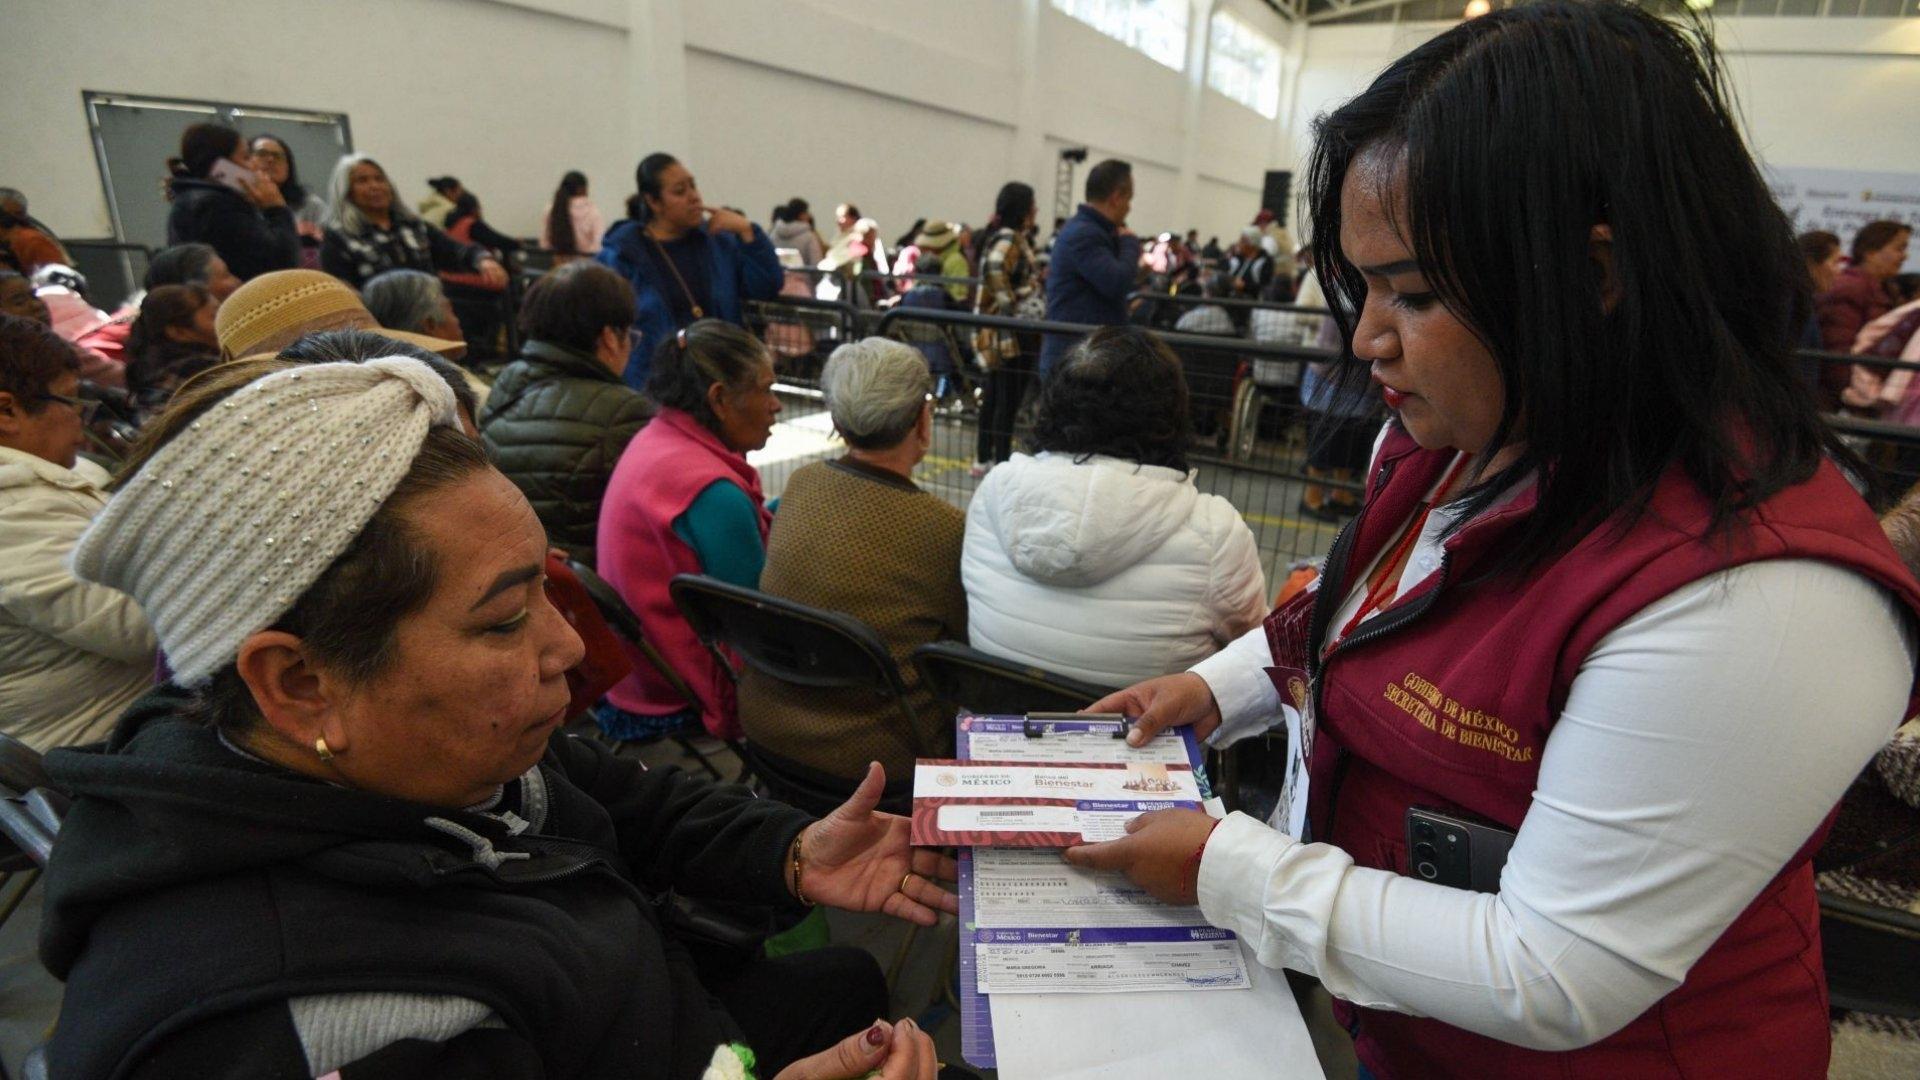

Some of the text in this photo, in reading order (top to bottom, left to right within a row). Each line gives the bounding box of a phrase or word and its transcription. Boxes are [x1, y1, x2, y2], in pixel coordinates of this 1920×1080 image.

[1444, 698, 1460, 718] DE
[1459, 707, 1519, 744] MÉXICO
[1441, 719, 1457, 740] DE
[1459, 729, 1533, 762] BIENESTAR
[961, 778, 1011, 786] MÉXICO
[1034, 779, 1095, 788] Bienestar
